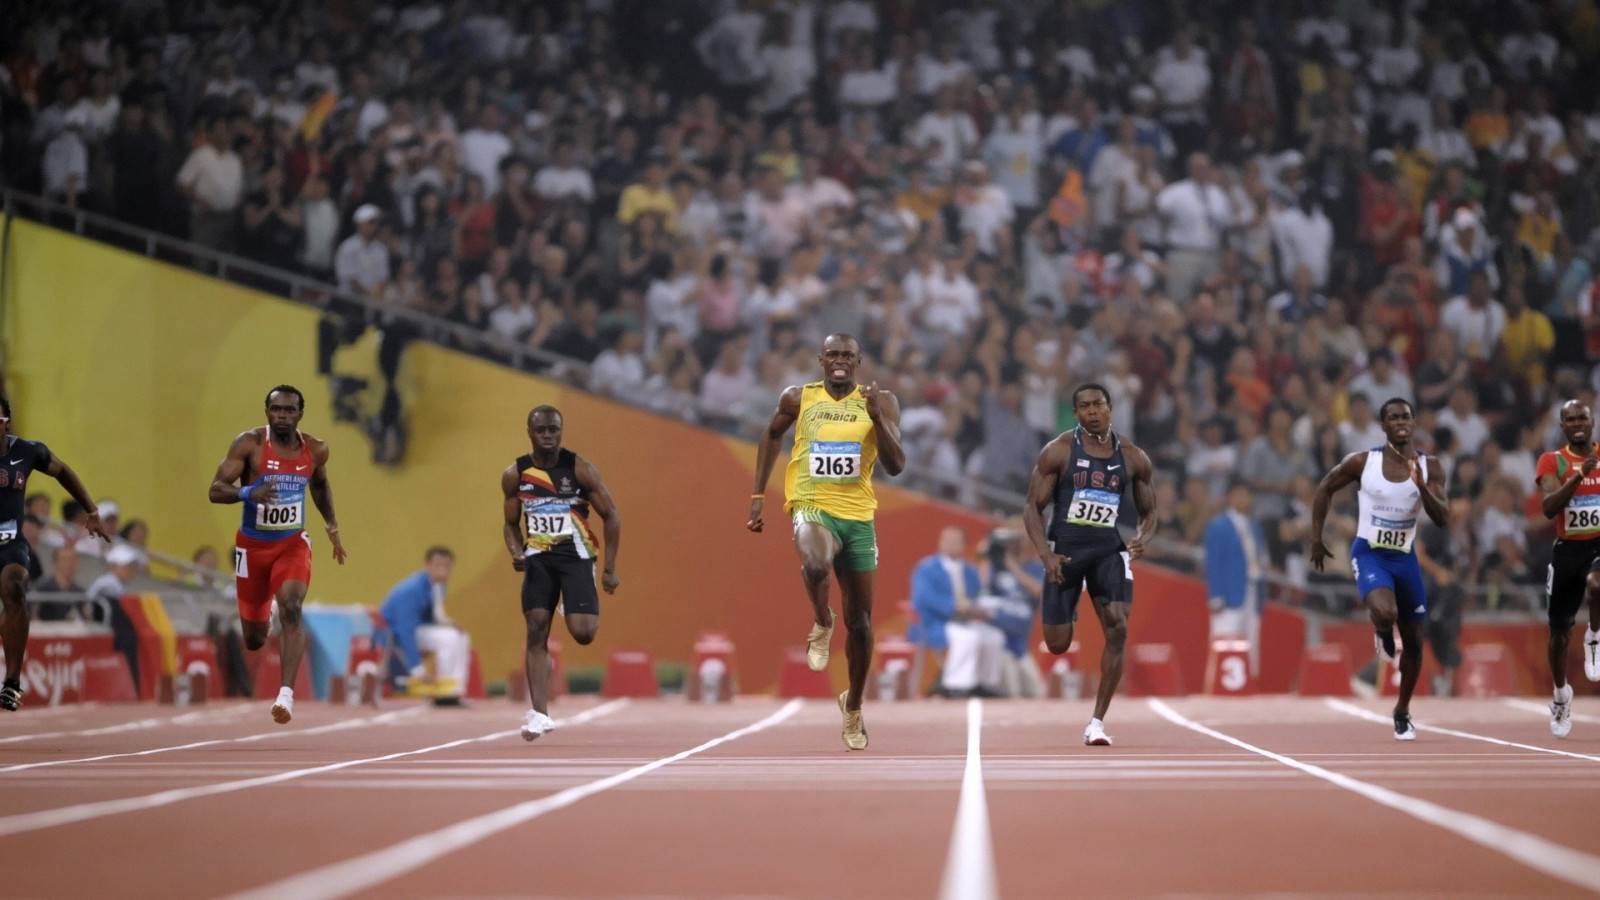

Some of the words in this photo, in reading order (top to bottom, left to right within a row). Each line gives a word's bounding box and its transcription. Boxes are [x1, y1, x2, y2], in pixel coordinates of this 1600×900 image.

[811, 409, 857, 422] jamaica
[815, 456, 854, 475] 2163
[1073, 471, 1120, 490] USA
[263, 505, 297, 524] 1003
[1075, 502, 1113, 523] 3152
[1569, 509, 1599, 528] 286
[531, 516, 565, 533] 3317
[1377, 530, 1406, 547] 1813
[1221, 655, 1247, 691] 3
